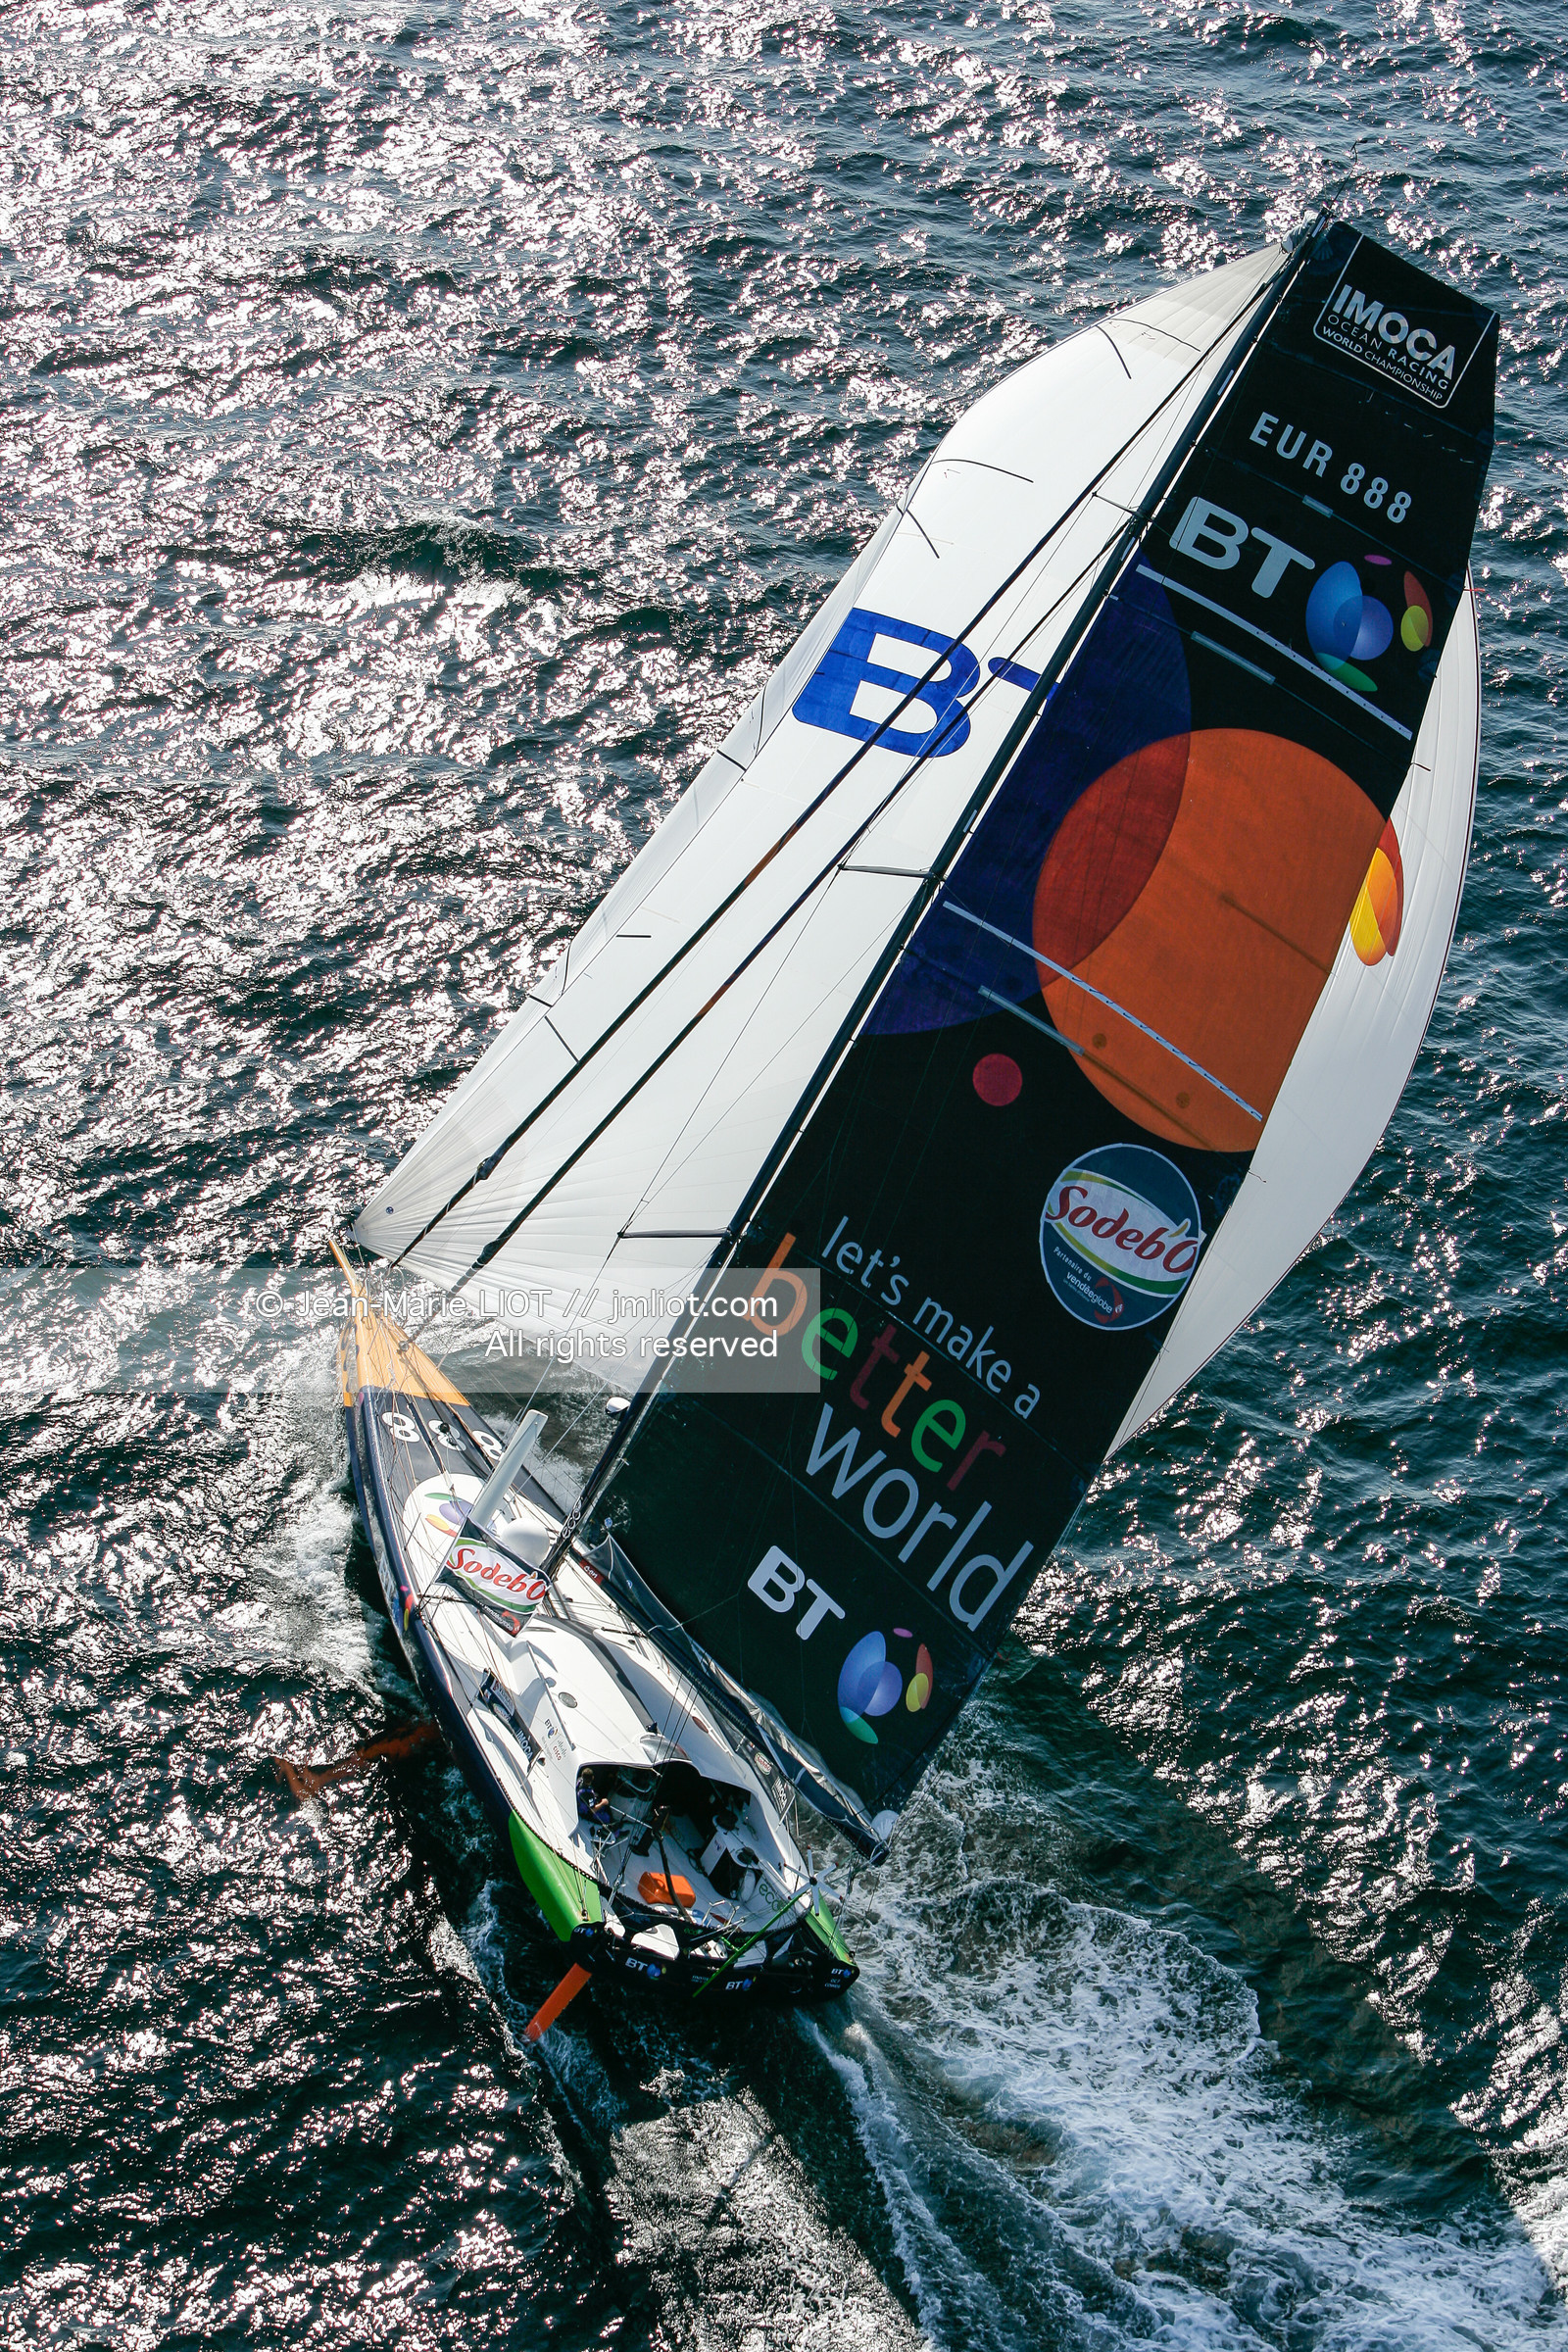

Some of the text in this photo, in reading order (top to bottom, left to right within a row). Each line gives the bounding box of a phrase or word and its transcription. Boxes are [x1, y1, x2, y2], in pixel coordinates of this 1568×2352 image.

[1322, 325, 1444, 401] WORLD CHAMPIONSHIP
[1327, 314, 1449, 390] OCEAN RACING
[1332, 284, 1456, 380] IMOCA
[1249, 412, 1413, 524] EUR 888
[1168, 496, 1316, 599] BT
[1053, 1246, 1083, 1274] Partenaire
[745, 1231, 1007, 1492] better
[821, 1215, 1042, 1420] let's make a
[806, 1401, 1035, 1632] world
[747, 1544, 846, 1641] BT
[516, 1730, 534, 1760] IMOCA
[625, 1957, 648, 1972] BT
[725, 1981, 743, 1991] BT
